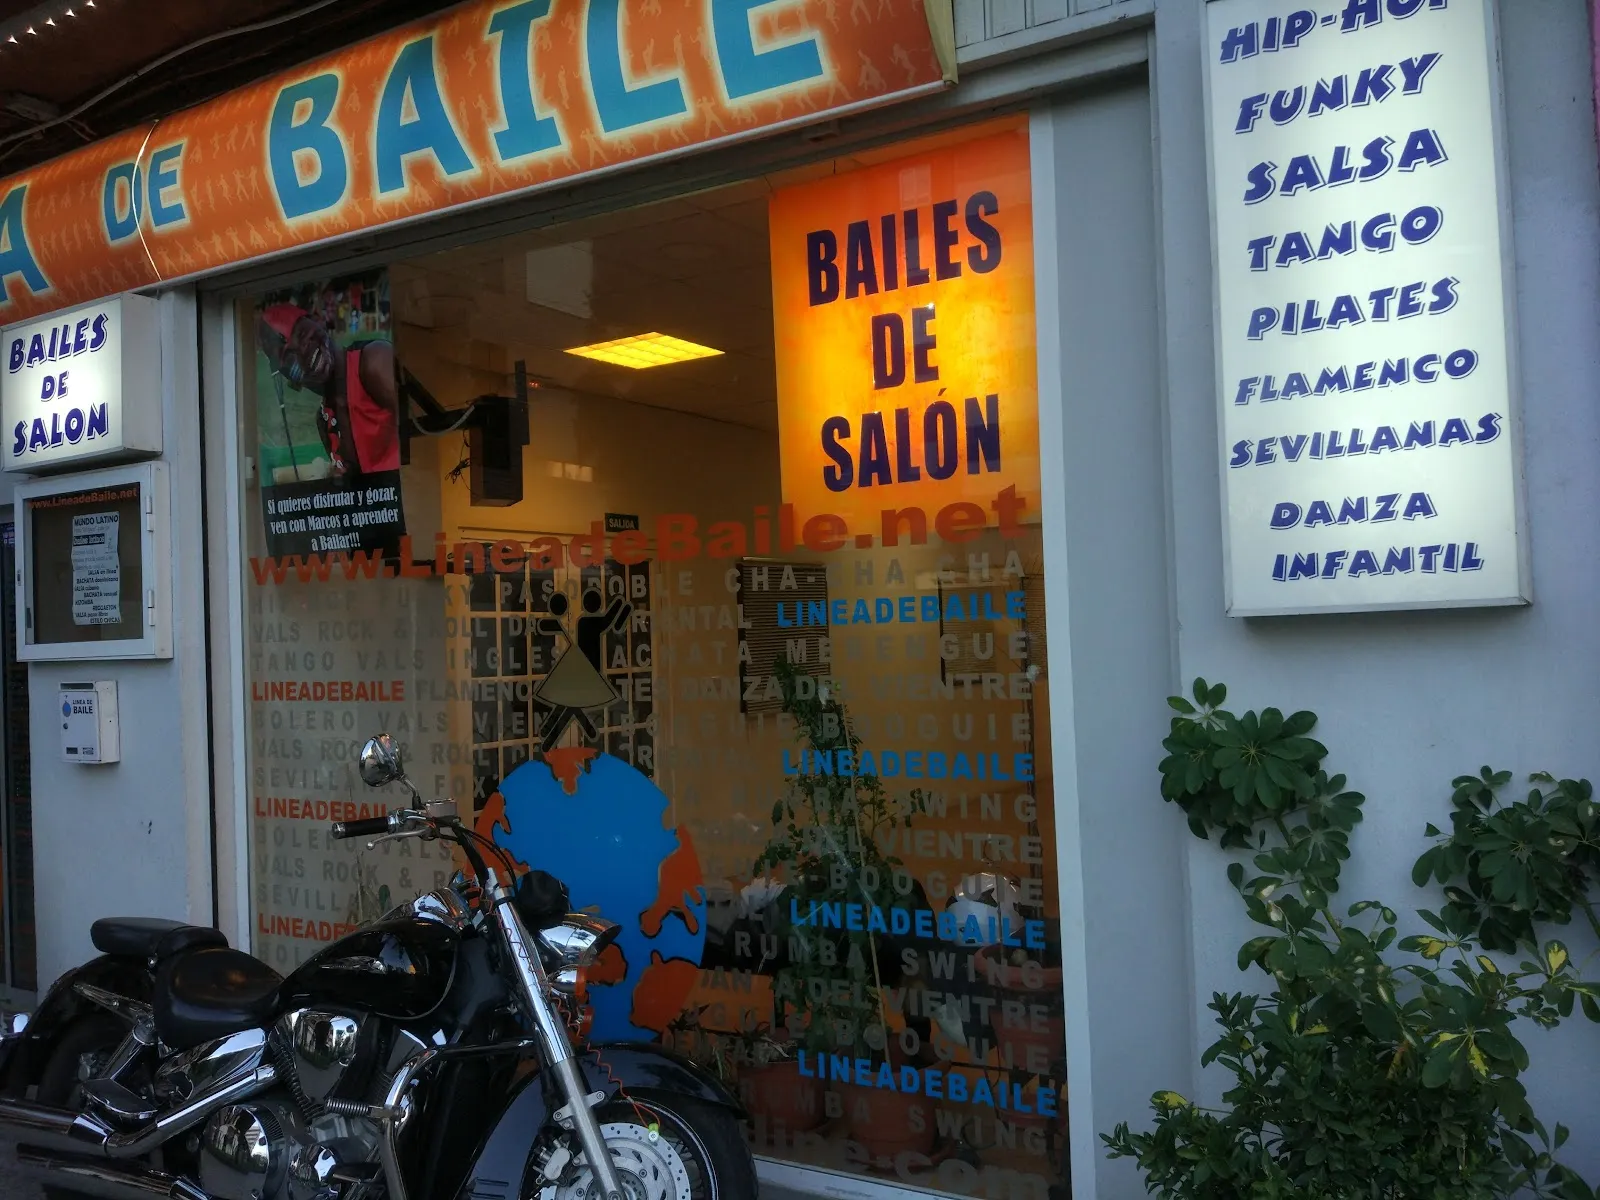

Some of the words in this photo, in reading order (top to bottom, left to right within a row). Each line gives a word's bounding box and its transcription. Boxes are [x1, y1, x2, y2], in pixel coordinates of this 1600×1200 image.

[1220, 0, 1447, 64] HIP-HO
[1235, 53, 1443, 134] FUNKY
[104, 143, 187, 242] DE
[270, 0, 825, 220] BAILE
[1243, 128, 1449, 205] SALSA
[807, 191, 1002, 307] BAILES
[1247, 206, 1443, 271] TANGO
[1247, 276, 1460, 340] PILATES
[9, 313, 109, 374] BAILES
[871, 304, 940, 391] DE
[41, 371, 69, 402] DE
[1234, 349, 1478, 405] FLAMENCO
[13, 402, 109, 457] SALON
[821, 387, 1002, 493] SALÓN
[1229, 412, 1503, 468] SEVILLANAS
[28, 488, 138, 510] www.LineadeBaile.net
[74, 517, 95, 527] MUNDO
[95, 514, 119, 525] LATINO
[267, 499, 276, 514] Si
[277, 496, 312, 516] quieres
[313, 491, 355, 510] disfrutar
[357, 490, 364, 506] y
[366, 486, 398, 505] gozar,
[270, 519, 288, 535] ven
[289, 518, 307, 533] con
[308, 513, 341, 531] Marcos
[343, 514, 350, 528] a
[351, 507, 399, 528] aprender
[609, 517, 636, 530] SALIDA
[1269, 492, 1437, 529] DANZA
[249, 484, 1028, 586] www.LineadeBaile.net
[311, 536, 319, 552] a
[319, 531, 361, 551] Bailar!!!
[1271, 542, 1484, 581] INFANTIL
[777, 590, 1027, 628] LINEADEBAILE
[252, 650, 336, 673] TANGO
[356, 649, 426, 671] VALS
[73, 706, 94, 715] BAILE
[252, 681, 405, 702] LINEADEBAILE
[378, 711, 449, 733] VALS
[255, 766, 411, 796] SEVILLA
[320, 740, 362, 763] ROC
[782, 749, 1034, 782] LINEADEBAILE
[255, 798, 405, 823] LINEADEBAI
[874, 826, 1043, 865] VIENTRE
[790, 898, 1047, 950] LINEADEBAILE
[797, 1048, 1060, 1119] LINEADEBAILE
